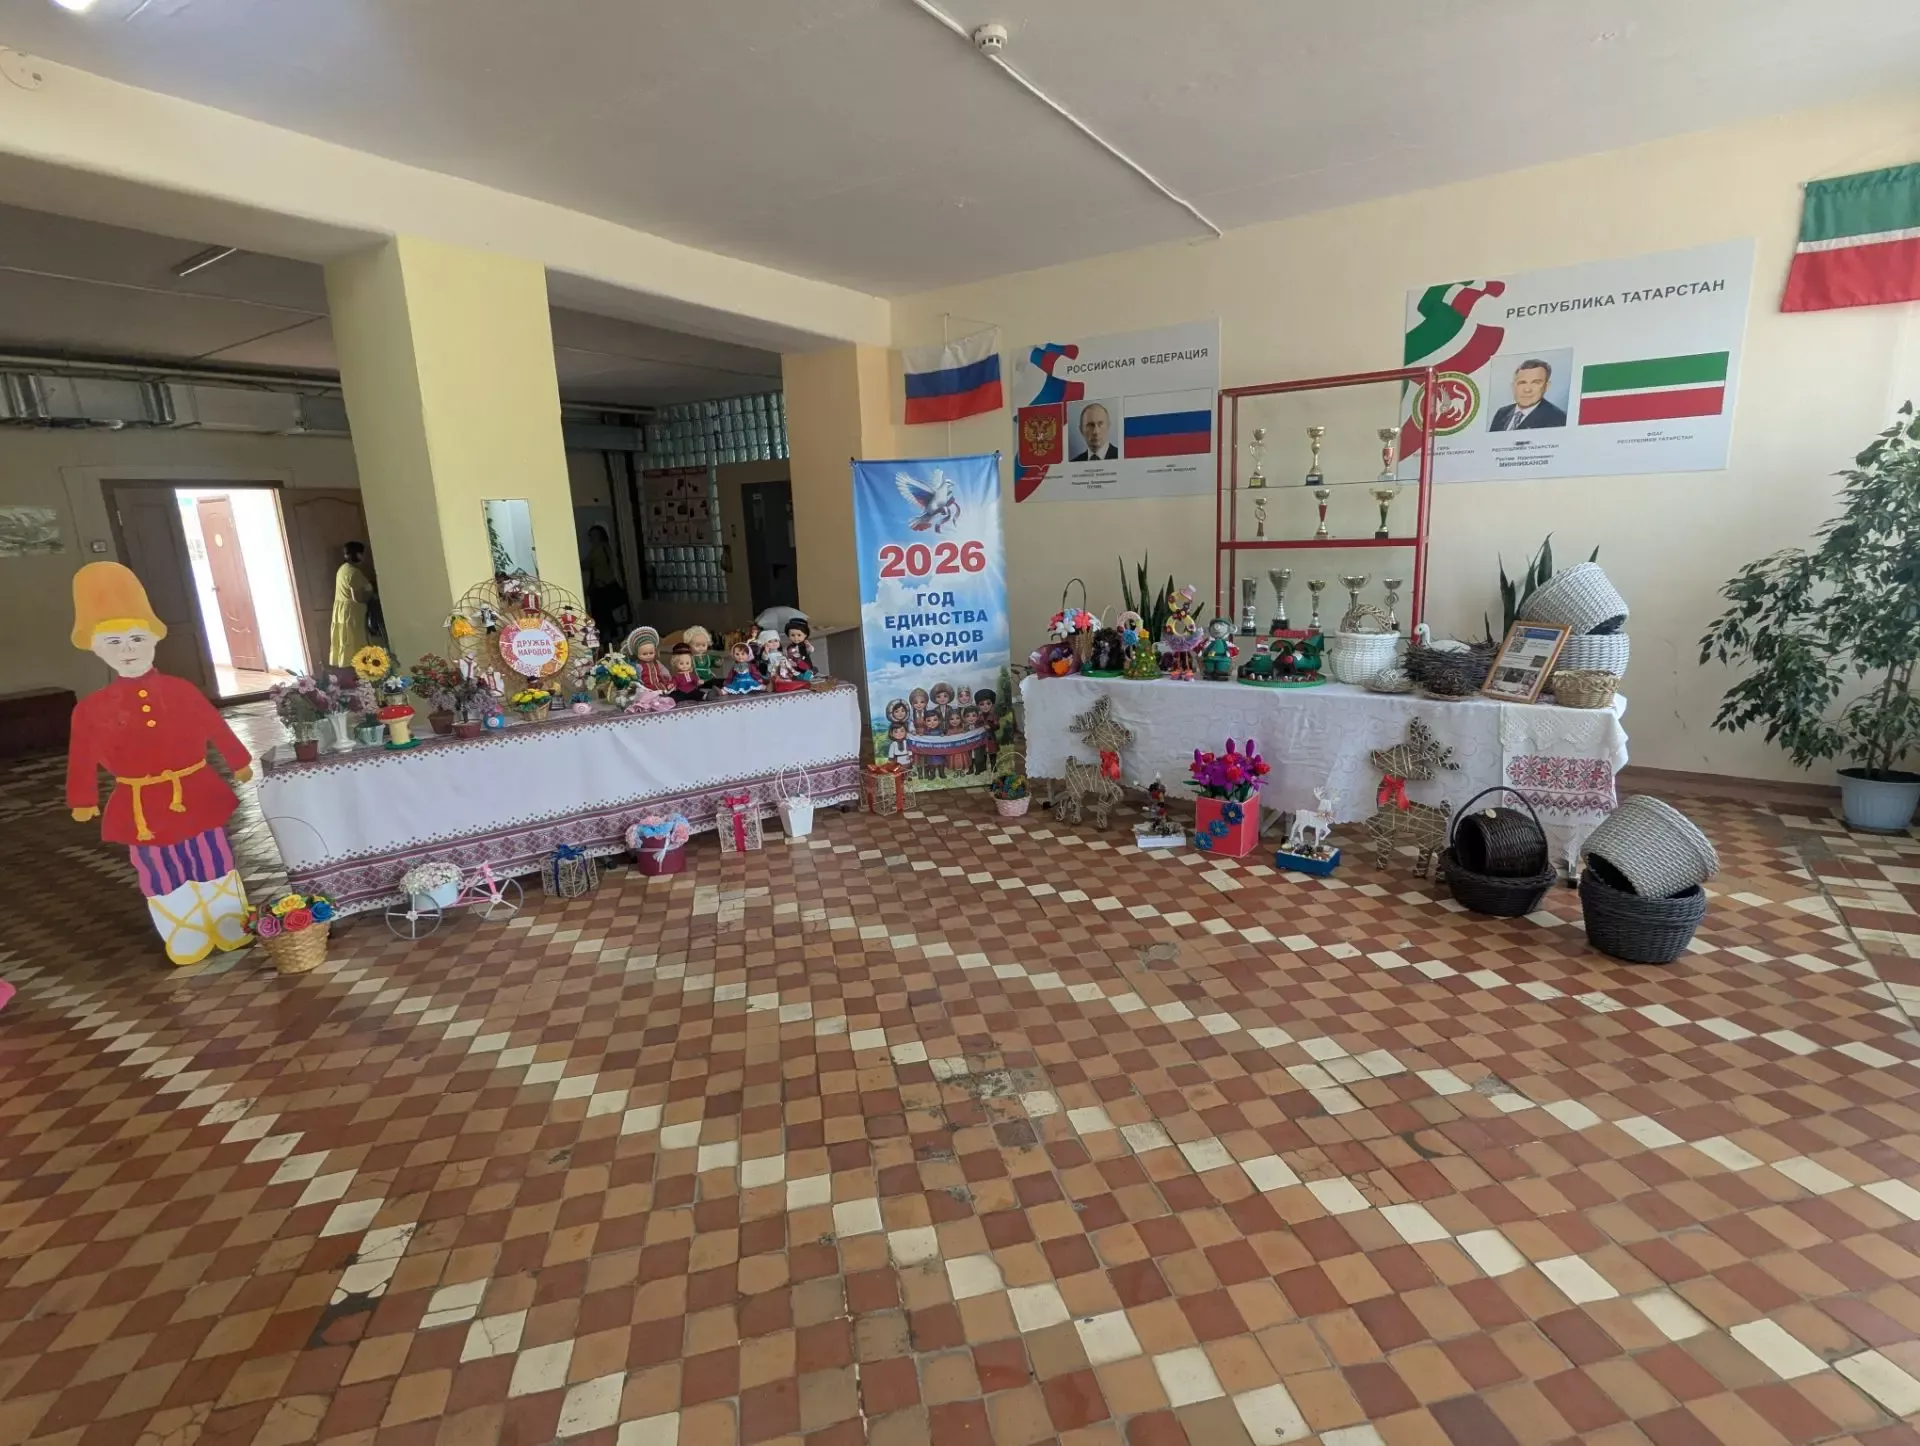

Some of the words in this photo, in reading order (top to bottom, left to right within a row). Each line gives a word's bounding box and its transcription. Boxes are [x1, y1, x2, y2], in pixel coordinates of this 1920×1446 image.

[1506, 294, 1615, 318] РЕСПУБЛИКА
[1621, 279, 1725, 304] ТАТАРСТАН
[1066, 358, 1135, 374] РОССИЙСКАЯ
[1140, 348, 1208, 364] ФЕДЕРАЦИЯ
[879, 540, 986, 578] 2026
[917, 591, 955, 607] ГОД
[885, 609, 988, 631] ЕДИНСТВА
[516, 639, 551, 648] ДРУЖБА
[892, 630, 984, 648] НАРОДОВ
[518, 647, 553, 656] НАРОДОВ
[900, 649, 978, 668] РОССИИ
